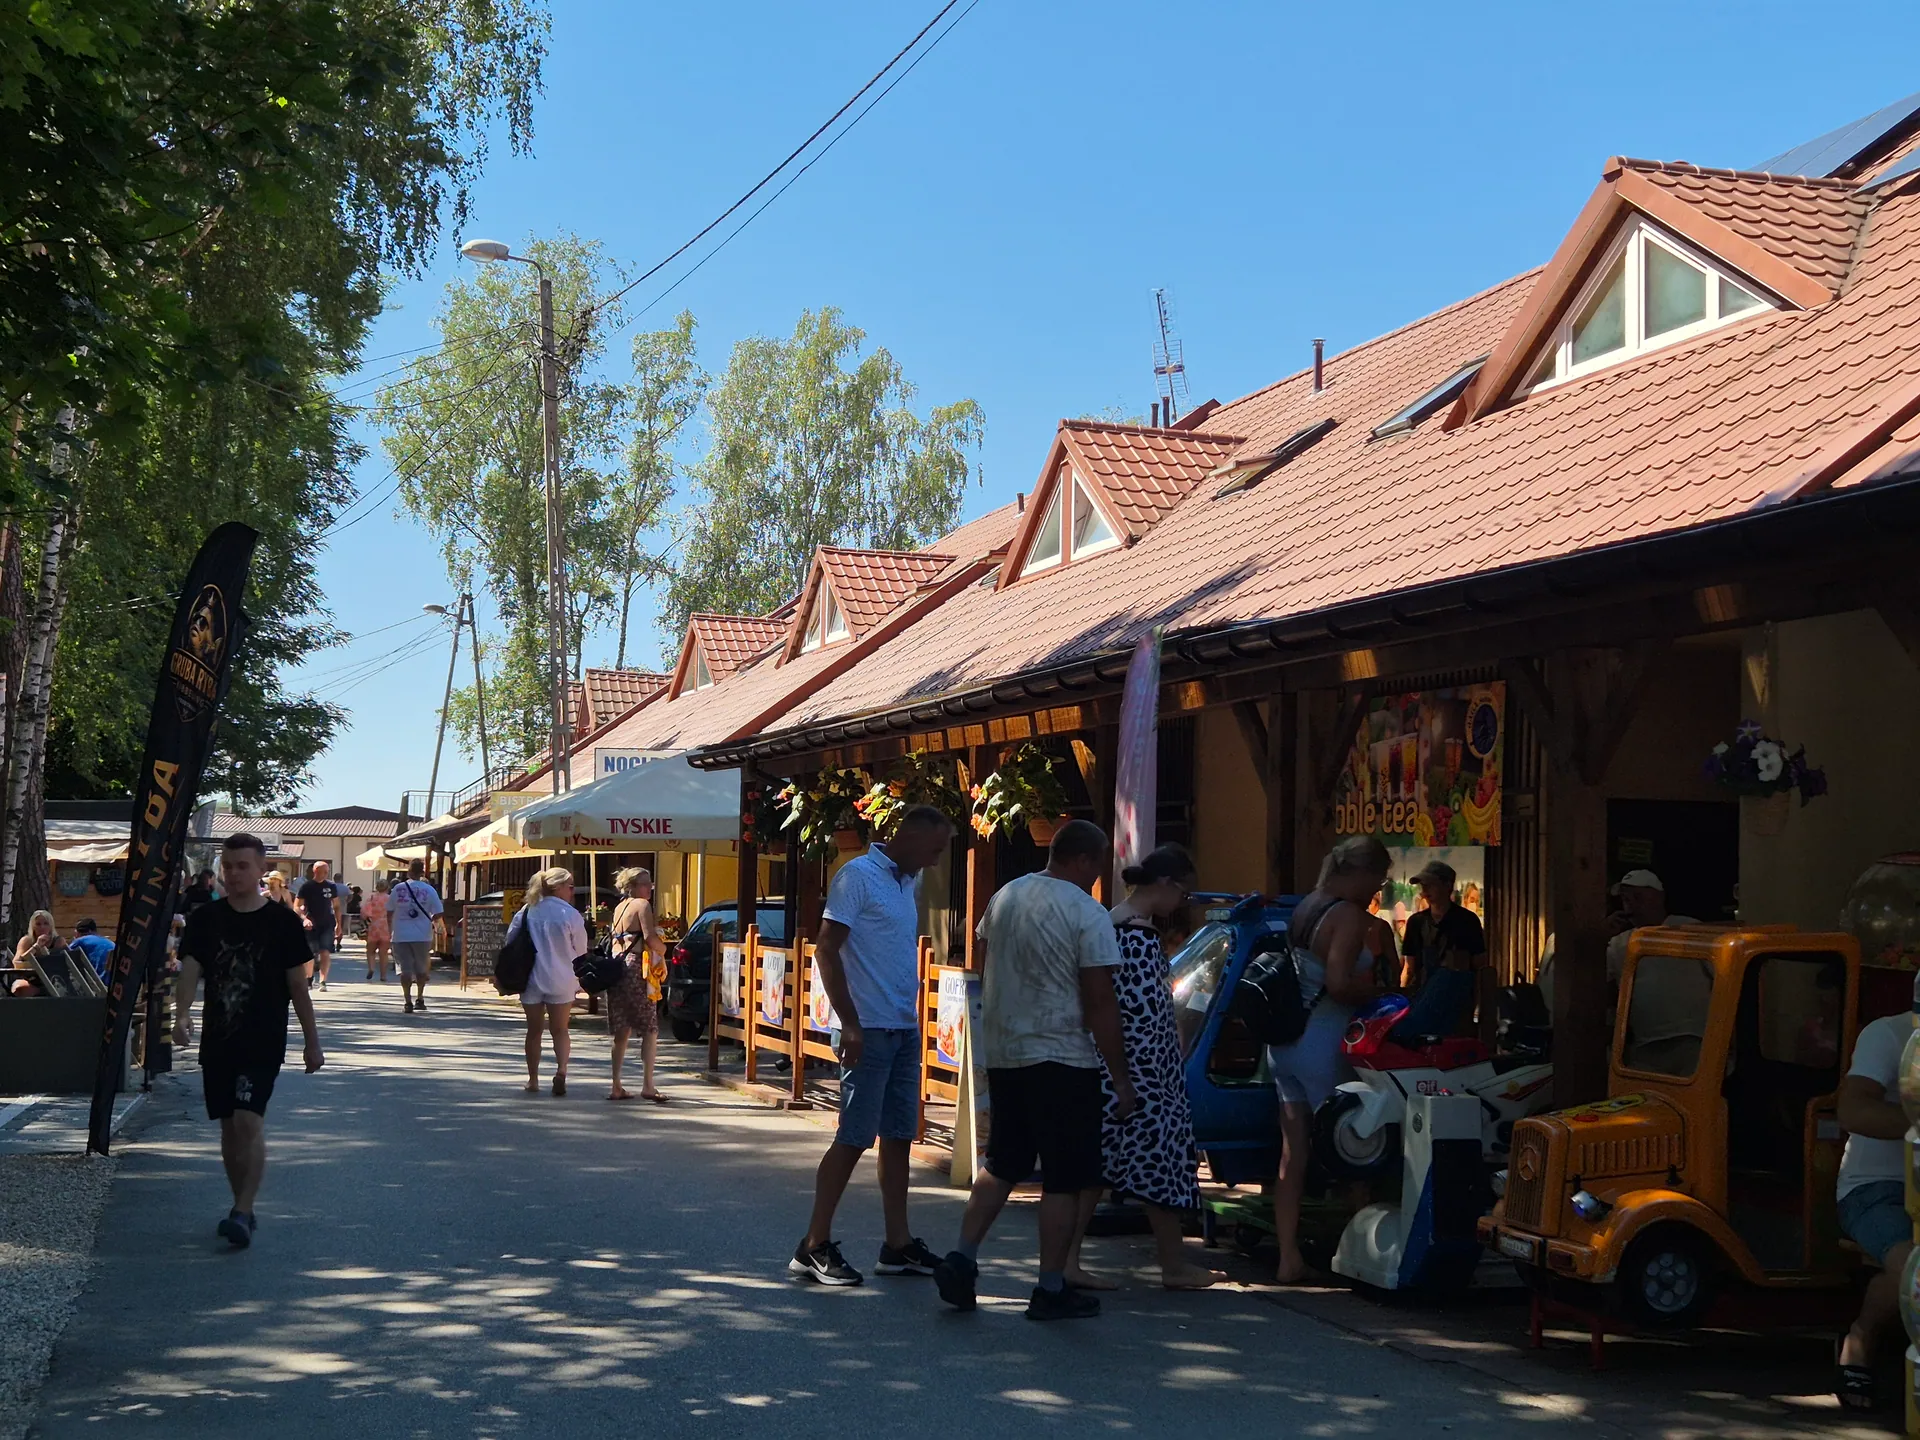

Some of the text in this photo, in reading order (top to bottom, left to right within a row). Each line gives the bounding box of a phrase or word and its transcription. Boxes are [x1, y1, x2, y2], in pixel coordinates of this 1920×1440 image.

[1382, 797, 1418, 834] tea
[606, 818, 673, 834] TYSKIE
[945, 976, 966, 996] GOFR
